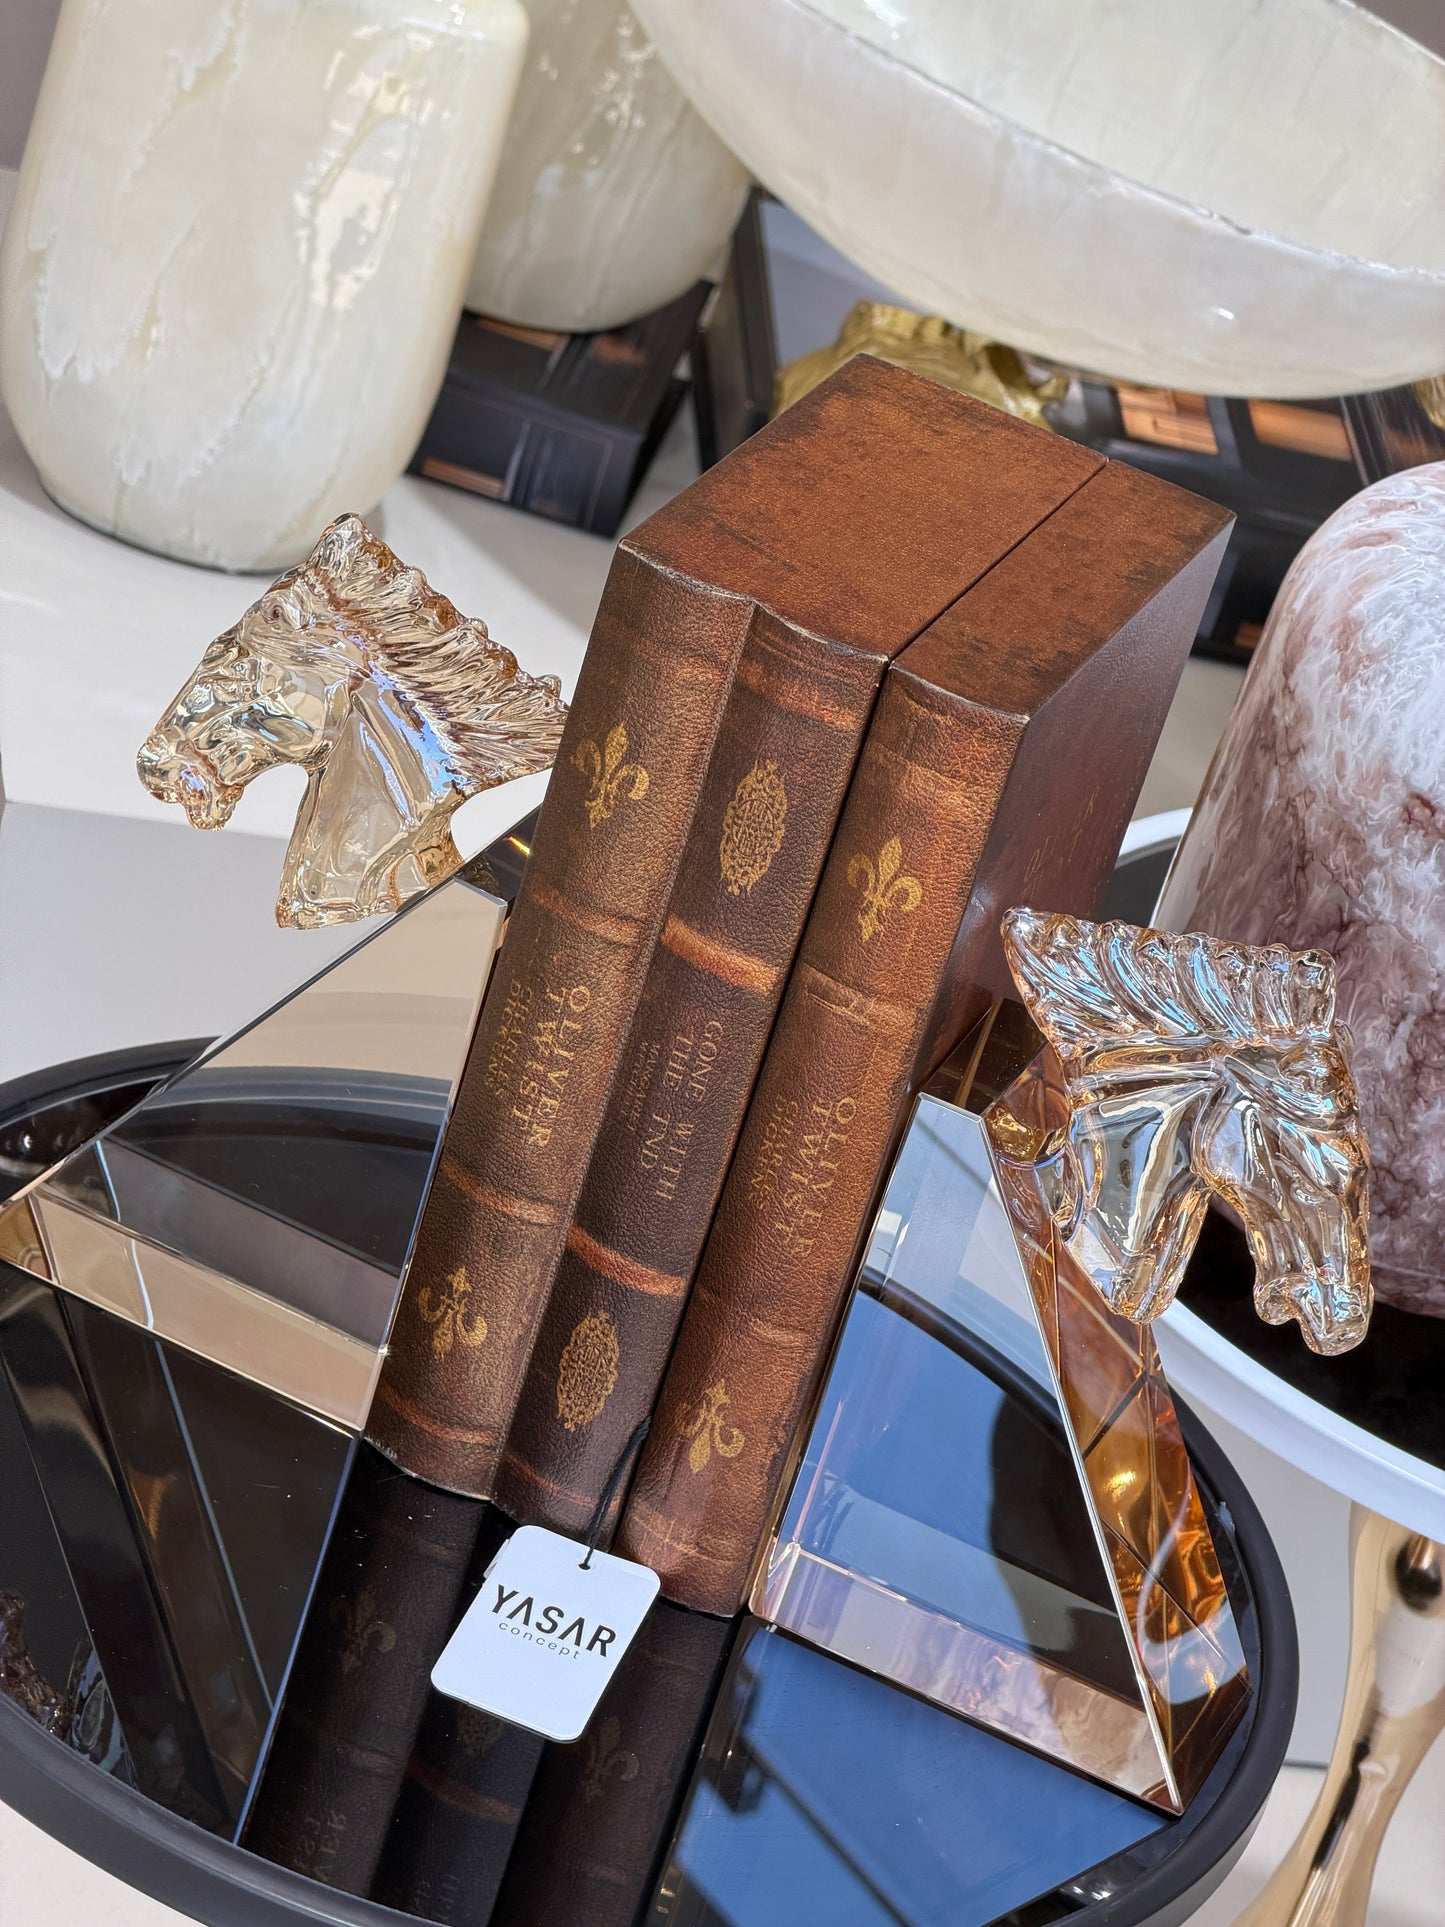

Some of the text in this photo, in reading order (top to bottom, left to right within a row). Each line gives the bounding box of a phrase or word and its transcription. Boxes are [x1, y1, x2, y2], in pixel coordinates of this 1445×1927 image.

[510, 985, 569, 1130] TWIST
[527, 984, 593, 1148] OLIVER
[655, 1020, 724, 1201] GONE WITH
[774, 1098, 834, 1246] TWIST
[789, 1096, 857, 1256] OLIVER
[491, 1583, 617, 1658] YASAR
[498, 1620, 581, 1660] concept
